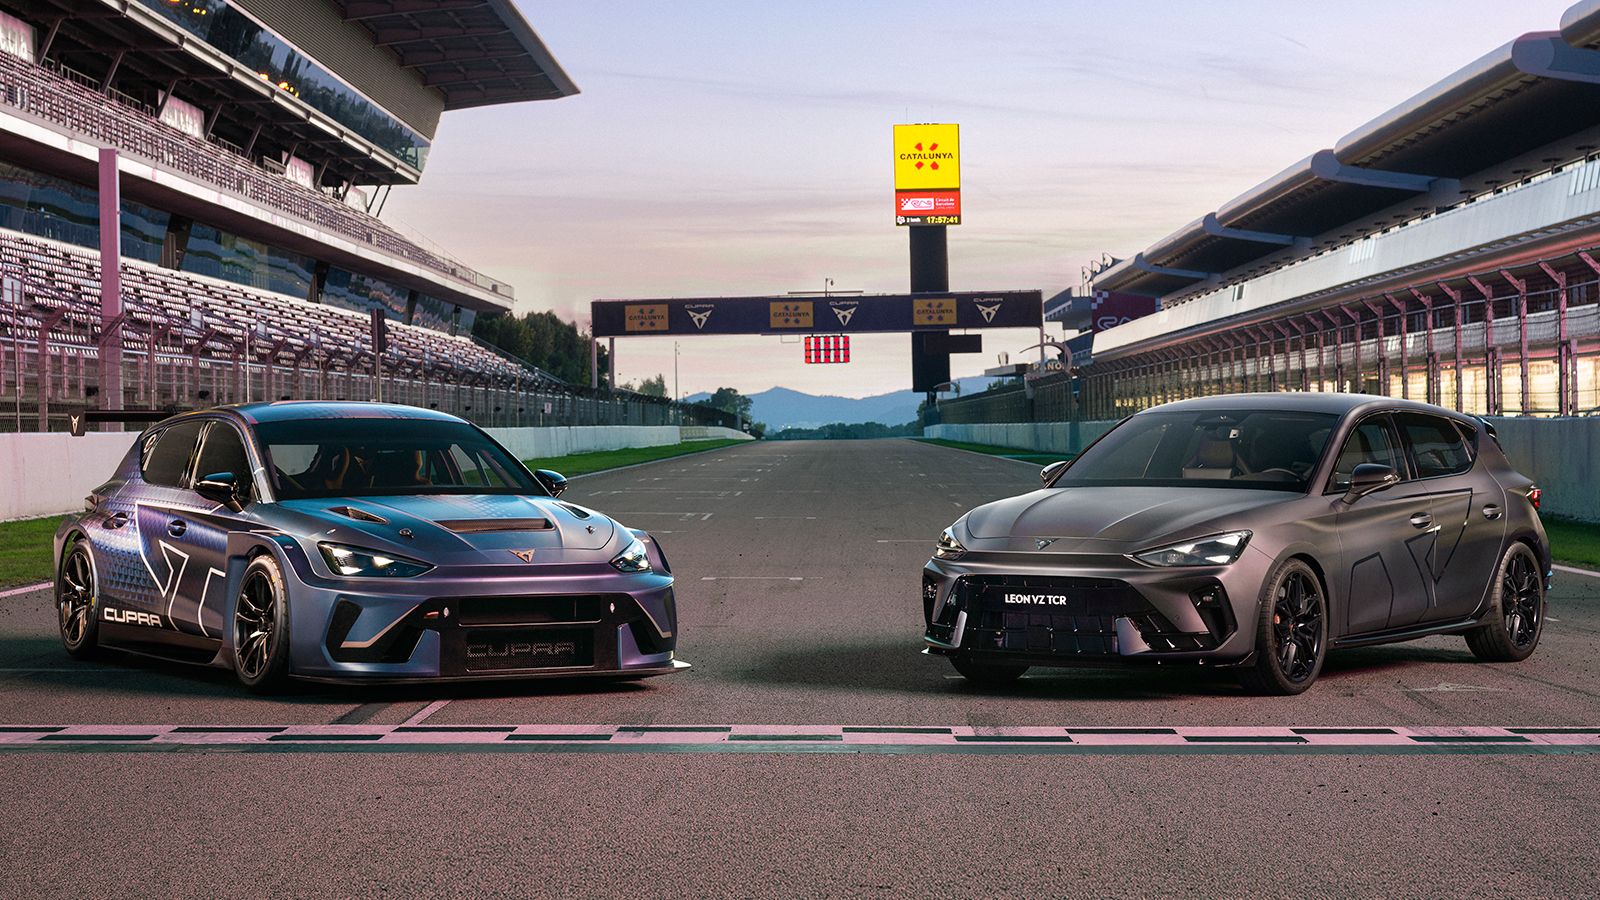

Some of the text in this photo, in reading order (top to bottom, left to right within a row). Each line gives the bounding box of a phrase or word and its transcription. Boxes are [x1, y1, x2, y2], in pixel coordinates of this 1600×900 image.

[1005, 594, 1067, 605] LEON VZ TCR
[104, 607, 162, 627] CUPRA
[466, 642, 575, 657] CUPRA
